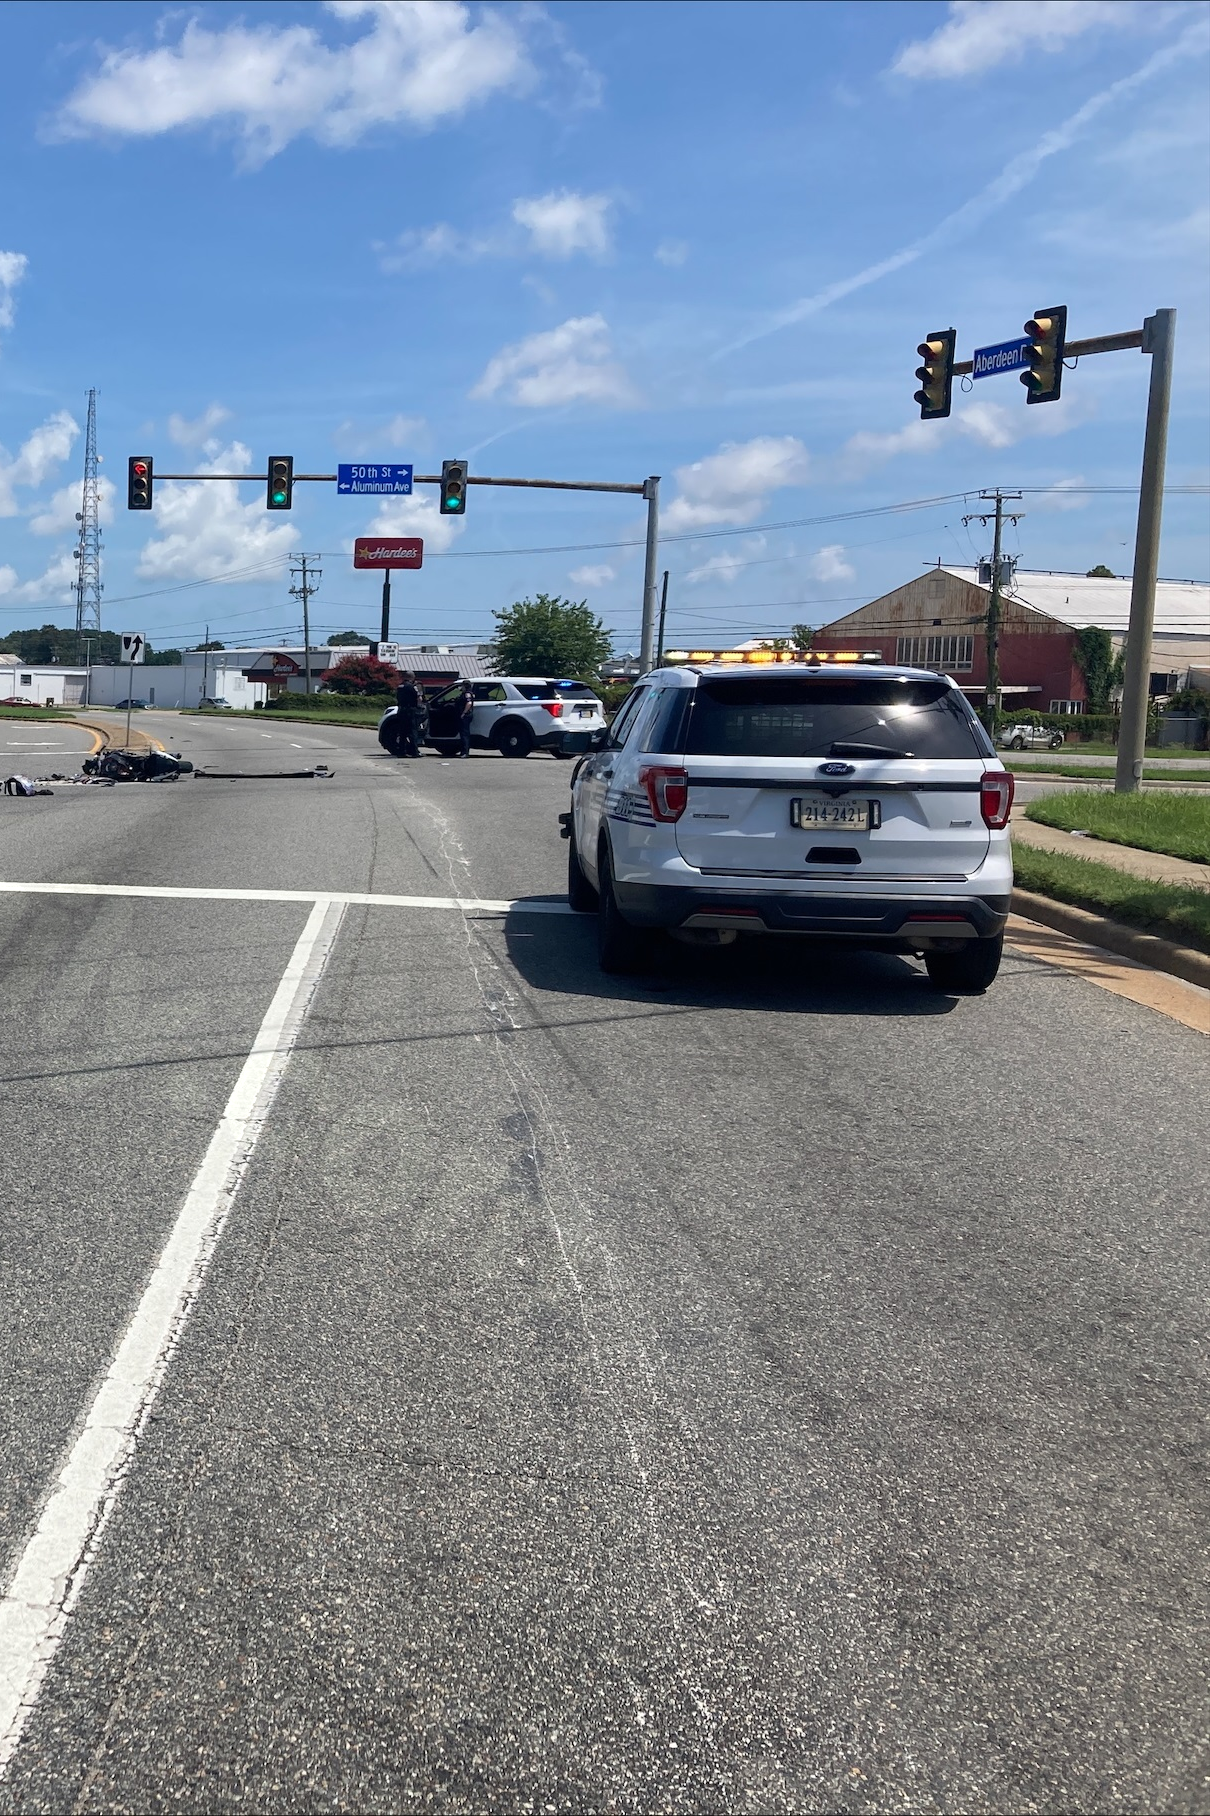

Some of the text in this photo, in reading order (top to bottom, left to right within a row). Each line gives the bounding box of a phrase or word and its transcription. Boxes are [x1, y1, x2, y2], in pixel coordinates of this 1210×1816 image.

[975, 350, 1018, 373] Aberdeen
[381, 466, 392, 478] St
[351, 480, 409, 492] Aluminum Ave
